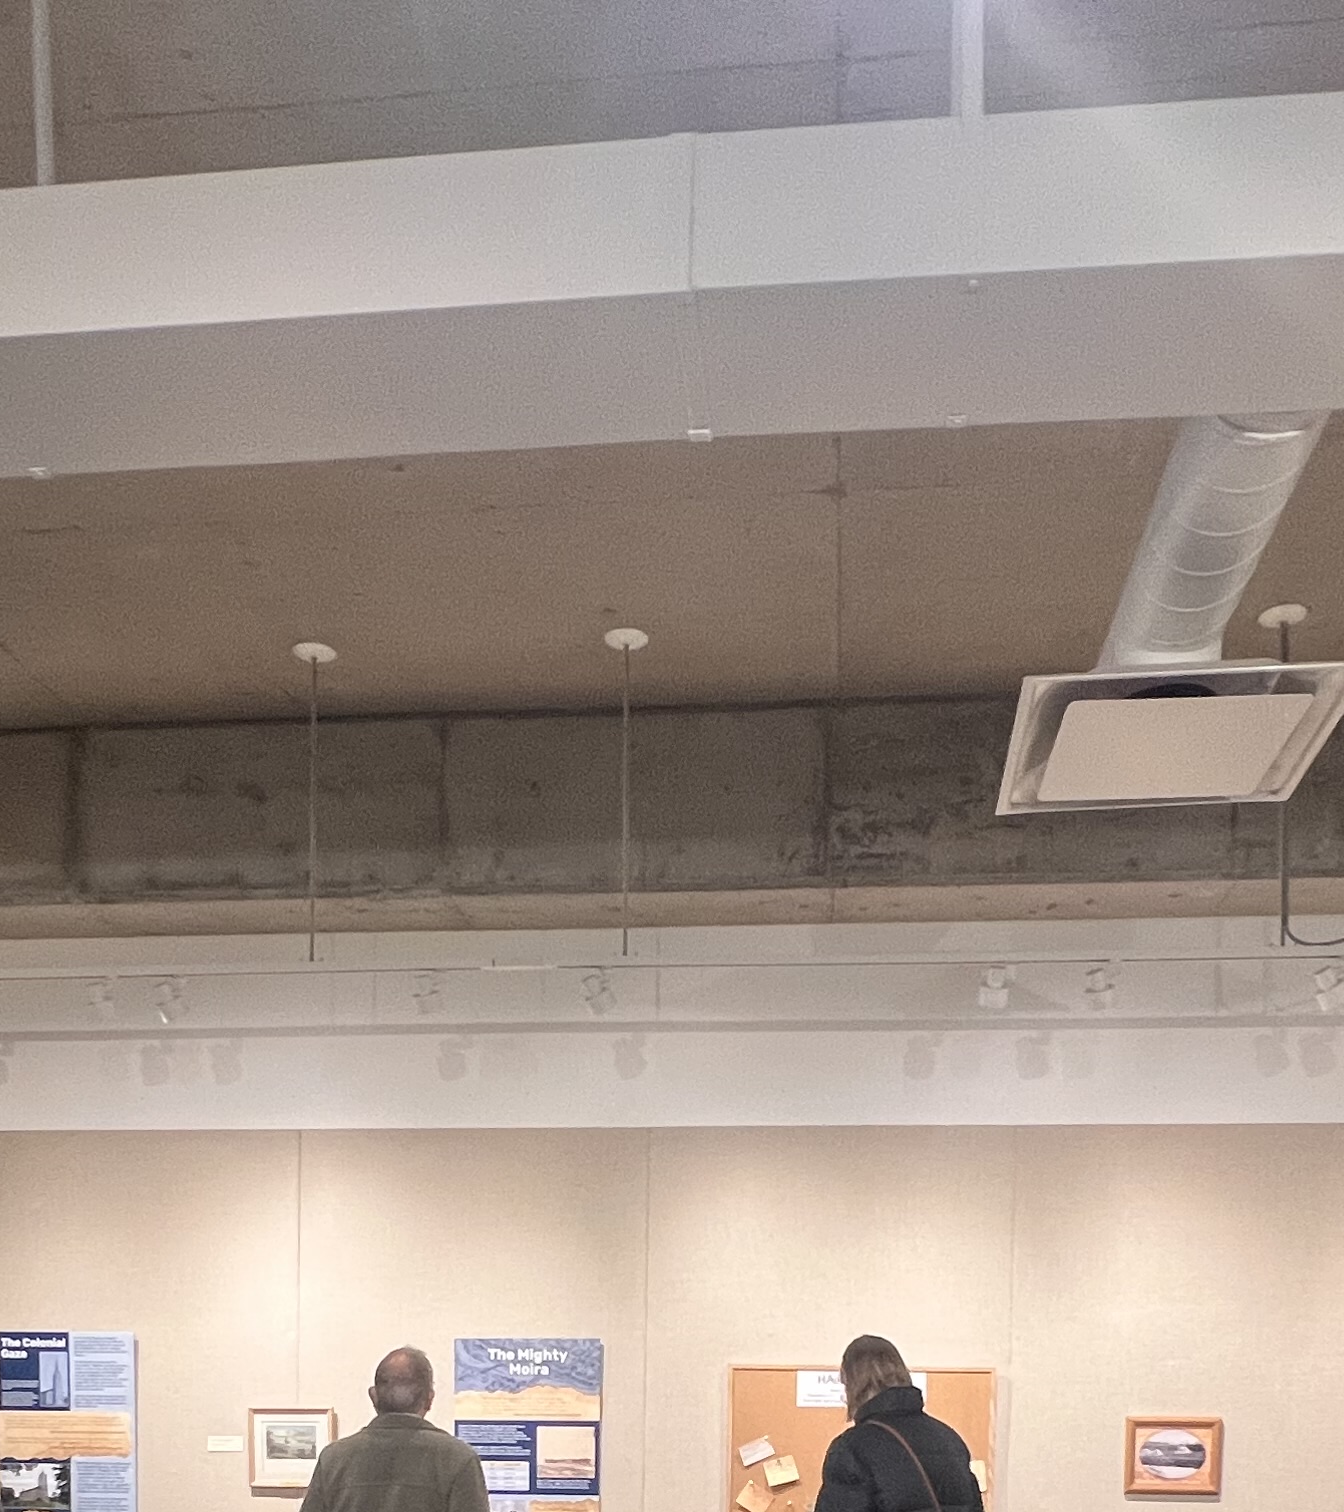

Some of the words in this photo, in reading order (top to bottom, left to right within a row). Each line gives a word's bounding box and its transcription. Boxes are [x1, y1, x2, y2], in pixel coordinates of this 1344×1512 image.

[0, 1337, 21, 1348] The
[22, 1337, 66, 1348] Colonial
[0, 1348, 28, 1359] Gaze
[487, 1347, 515, 1361] The
[517, 1347, 568, 1363] Mighty
[509, 1362, 550, 1376] Moira
